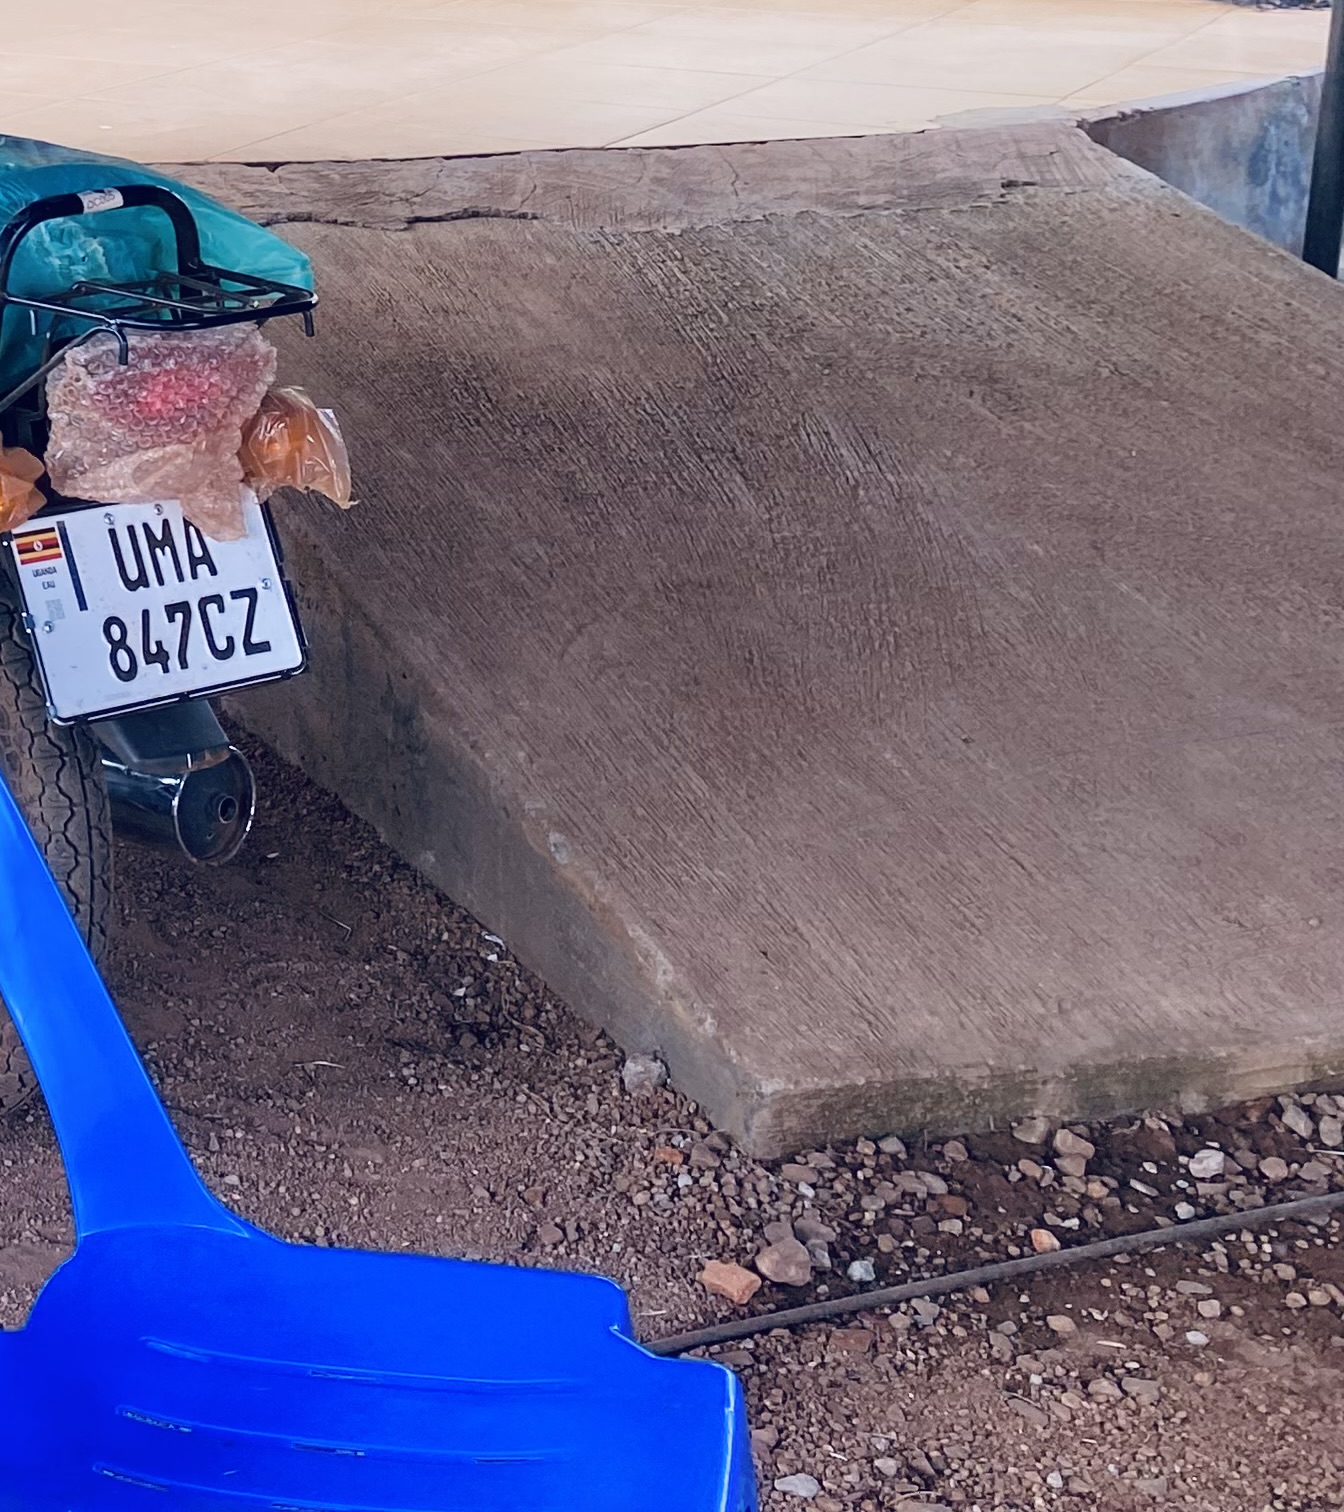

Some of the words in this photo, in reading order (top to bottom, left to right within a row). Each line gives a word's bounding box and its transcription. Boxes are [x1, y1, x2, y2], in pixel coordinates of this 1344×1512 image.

[32, 566, 58, 578] UGANDA
[108, 516, 218, 593] UMA
[42, 579, 56, 590] EAU
[102, 586, 272, 683] 847CZ
